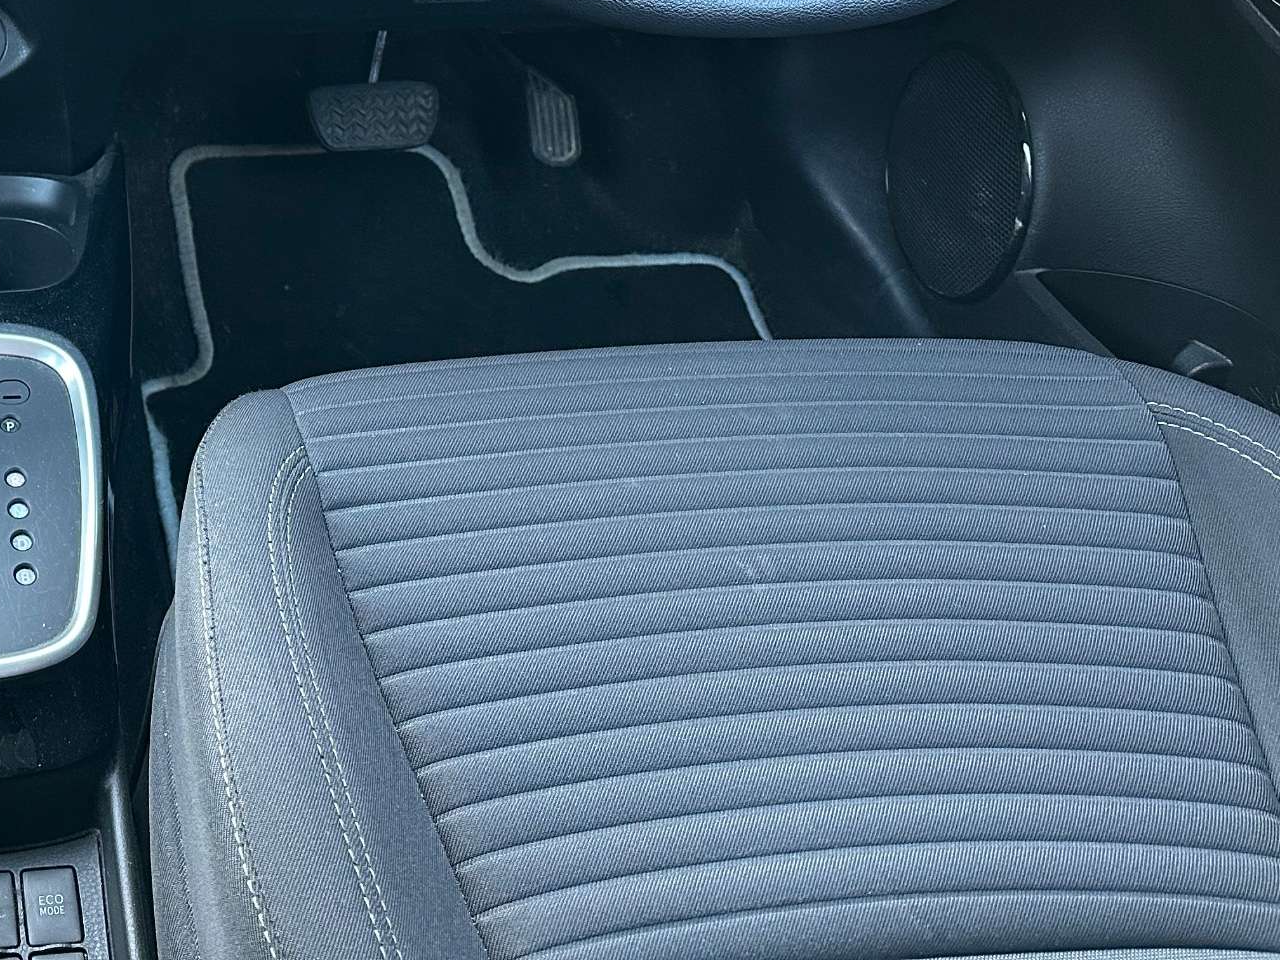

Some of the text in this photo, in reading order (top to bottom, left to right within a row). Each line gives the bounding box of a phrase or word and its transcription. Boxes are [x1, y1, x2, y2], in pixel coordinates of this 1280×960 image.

[6, 421, 15, 432] P
[38, 894, 64, 906] ECO
[39, 905, 65, 917] MODE
